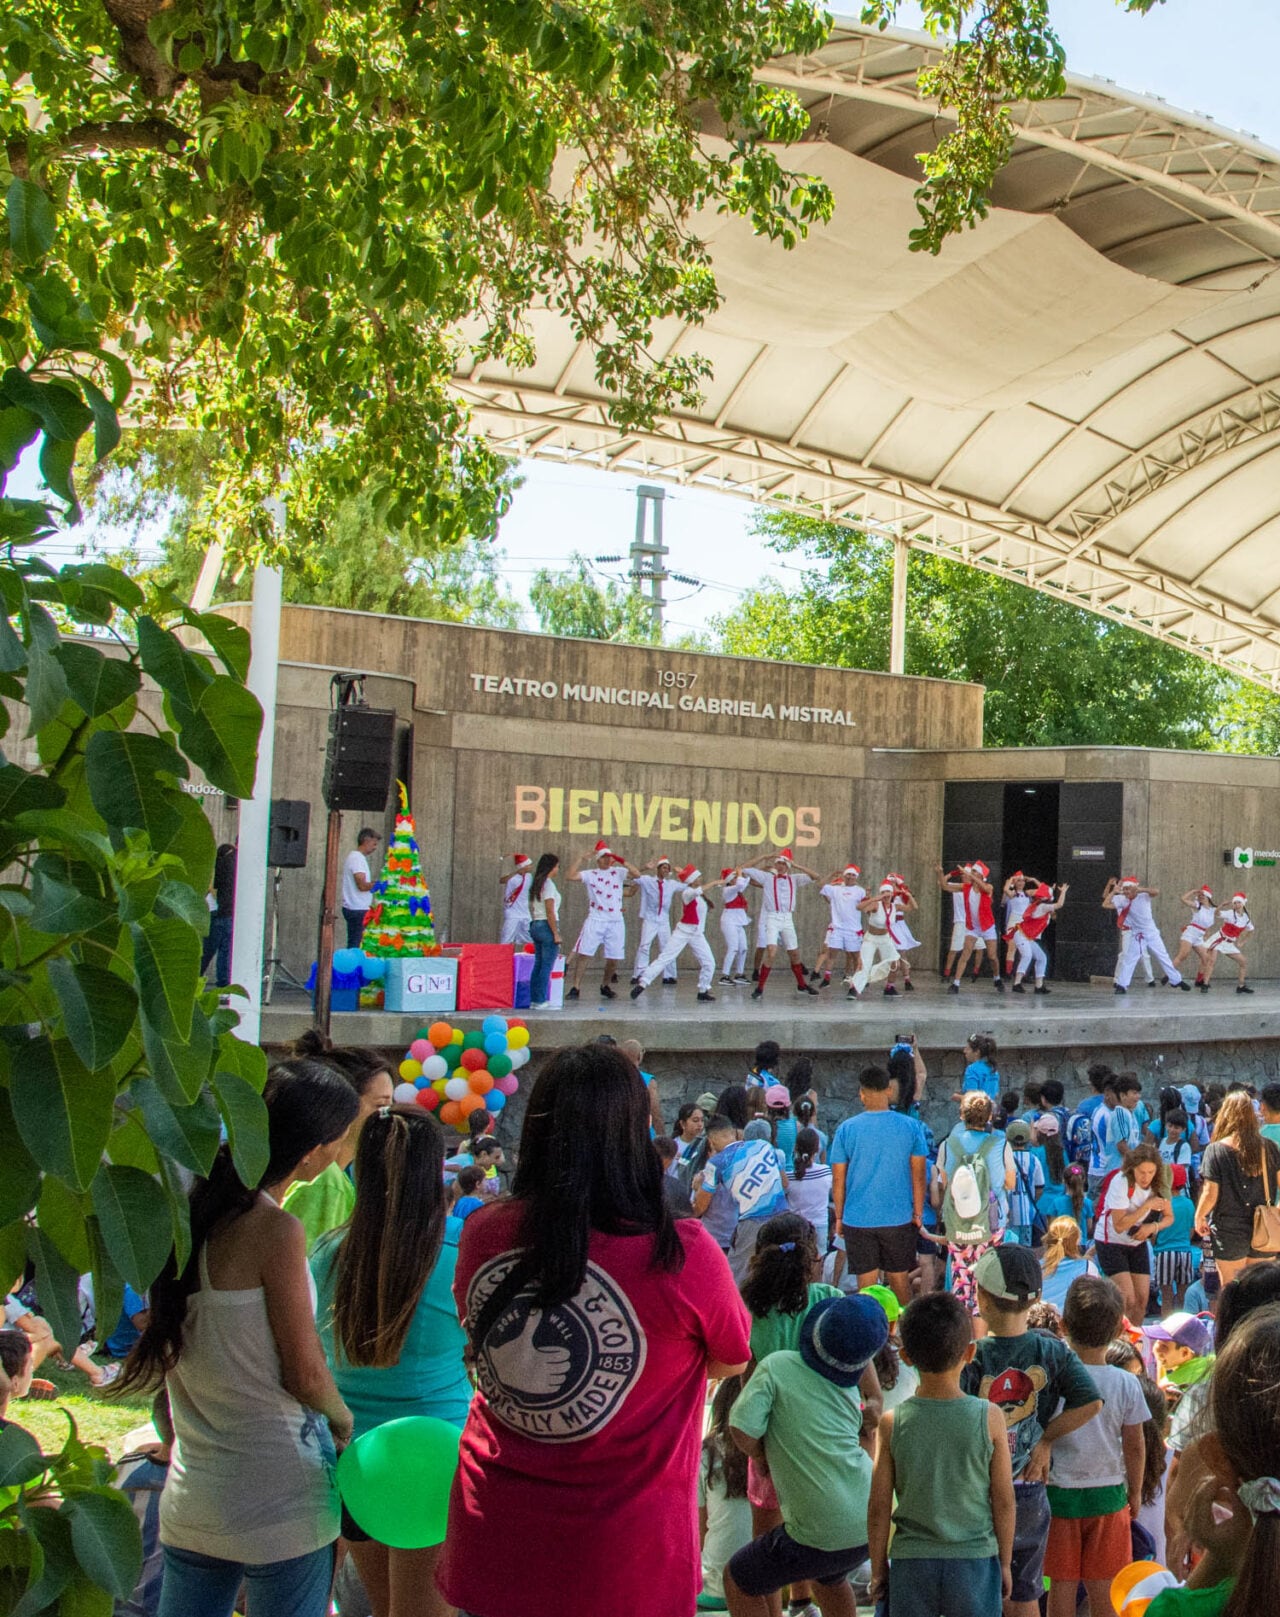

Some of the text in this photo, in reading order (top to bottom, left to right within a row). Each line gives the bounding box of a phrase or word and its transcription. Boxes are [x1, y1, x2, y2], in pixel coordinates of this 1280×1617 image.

[657, 670, 698, 689] 1957
[470, 674, 856, 726] TEATRO MUNICIPAL GABRIELA MISTRAL
[182, 783, 224, 795] endoza
[514, 785, 821, 847] BIENVENIDOS
[739, 1150, 778, 1199] ARG
[496, 1309, 574, 1341] DONE WELL
[599, 1318, 628, 1348] CO
[599, 1356, 633, 1372] 1853
[1003, 1378, 1012, 1390] A
[559, 1375, 619, 1429] MADE
